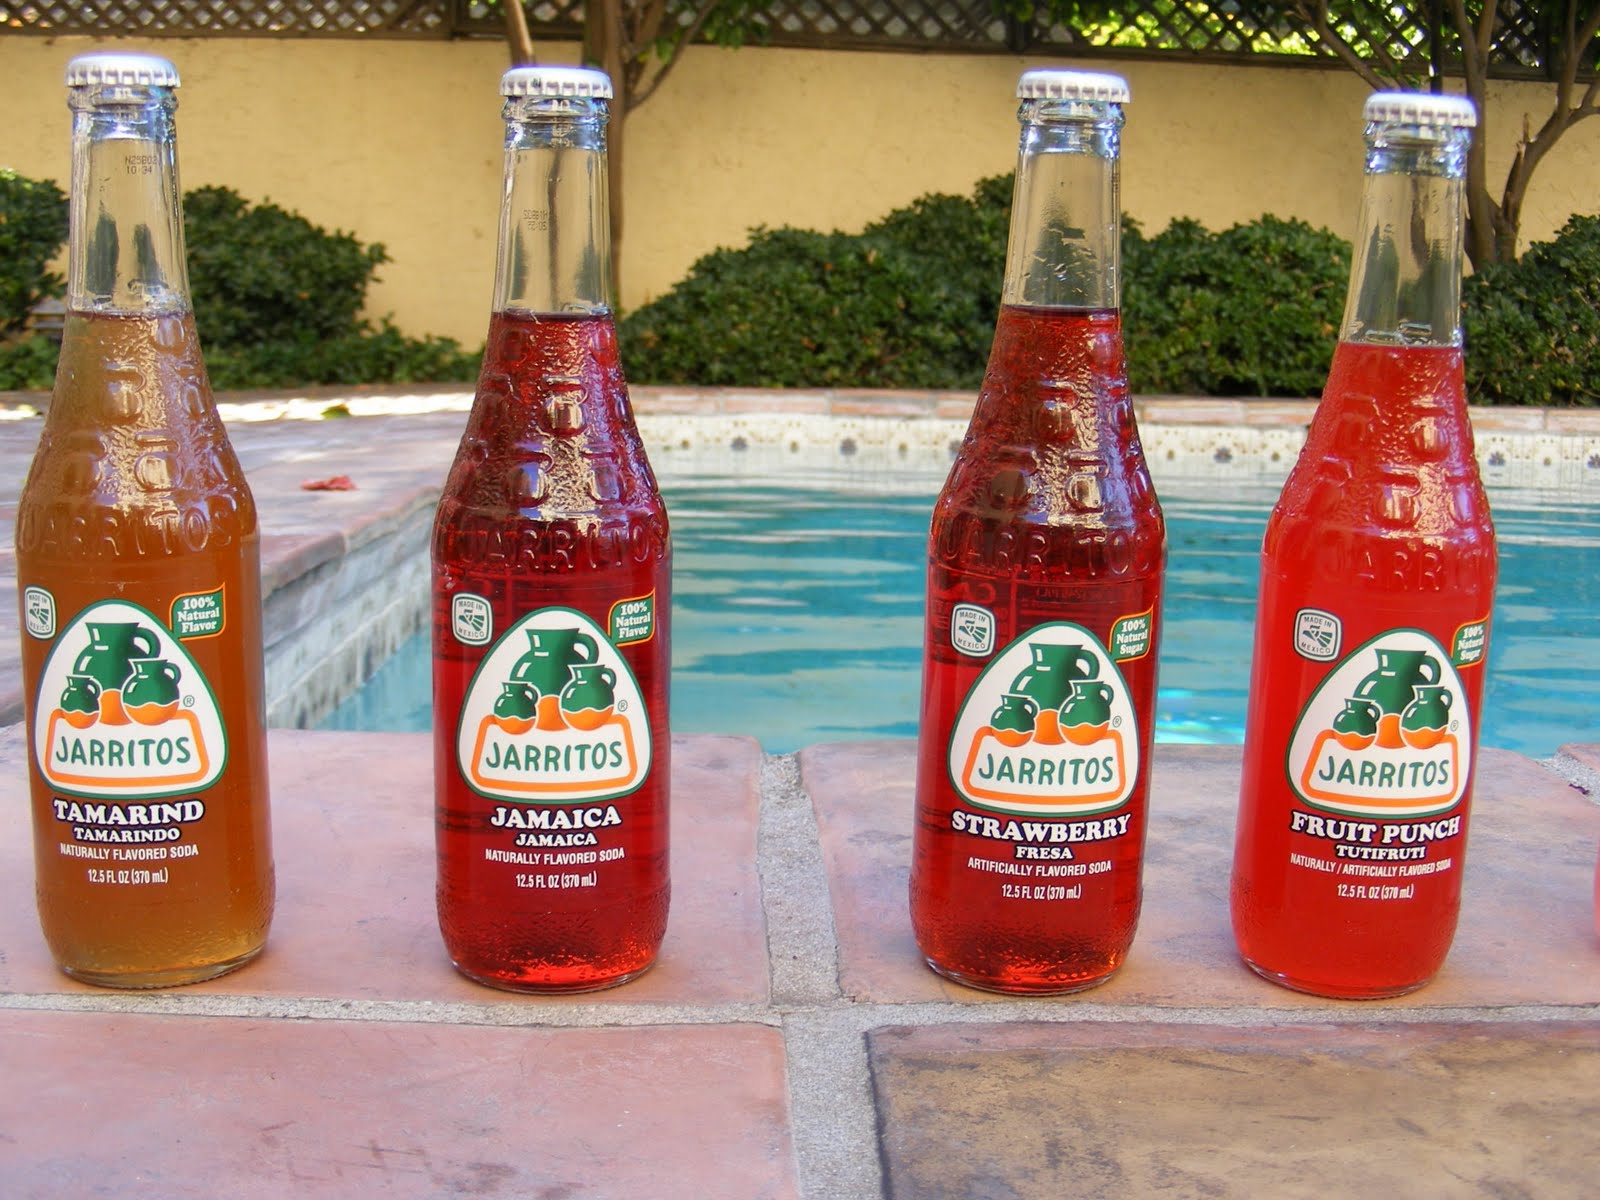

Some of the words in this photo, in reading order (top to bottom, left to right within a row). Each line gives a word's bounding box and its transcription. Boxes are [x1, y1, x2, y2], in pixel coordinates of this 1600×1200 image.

[182, 596, 216, 610] 100%
[620, 601, 648, 616] 100%
[177, 607, 220, 622] Natural
[615, 612, 651, 628] Natural
[959, 611, 977, 619] MADE
[978, 615, 986, 623] IN
[1304, 616, 1323, 625] MADE
[1324, 620, 1332, 628] IN
[181, 621, 217, 633] Flavor
[618, 626, 649, 639] Flavor
[1121, 618, 1146, 632] 100%
[957, 638, 986, 649] MEXICO
[1116, 629, 1148, 644] Natural
[1120, 643, 1144, 656] Sugar
[1301, 642, 1331, 654] MEXICO
[56, 736, 191, 766] JARRITOS
[486, 741, 623, 771] JARRITOS
[978, 753, 1114, 785] JARRITOS
[1319, 755, 1450, 787] JARRITOS
[54, 799, 204, 825] TAMARIND
[490, 806, 622, 829] JAMAICA
[73, 827, 181, 843] TAMARINDO
[952, 811, 1131, 843] STRAWBERRY
[1291, 811, 1376, 843] FRUIT
[1381, 815, 1461, 843] PUNCH
[515, 833, 598, 847] JAMAICA
[60, 843, 110, 860] NATURALLY
[113, 848, 167, 860] FLAVORED
[170, 844, 199, 858] SODA
[485, 849, 541, 865] NATURALLY
[544, 852, 597, 865] FLAVORED
[599, 848, 625, 862] SODA
[1016, 846, 1073, 859] FRESA
[1336, 845, 1426, 860] TUTIFRUTI
[968, 857, 1033, 876] ARTIFICIALLY
[1035, 864, 1086, 877] FLAVORED
[1088, 860, 1112, 874] SODA
[1290, 853, 1336, 872] NATURALLY
[1342, 864, 1398, 877] ARTIFICIALLY
[1399, 863, 1435, 877] FLAVORED
[88, 869, 105, 883] 12.5
[106, 870, 116, 883] FL
[118, 871, 129, 884] OZ
[131, 869, 150, 885] (370
[152, 867, 169, 884] mL)
[516, 874, 534, 888] 12.5
[536, 875, 546, 888] FL
[548, 875, 559, 889] OZ
[561, 873, 579, 889] (370
[581, 871, 597, 887] mL)
[1002, 884, 1019, 898] 12.5
[1022, 886, 1031, 899] FL
[1034, 886, 1045, 899] OZ
[1047, 885, 1065, 900] (370
[1067, 883, 1082, 899] mL)
[1337, 884, 1355, 897] 12.5
[1357, 886, 1366, 898] FL
[1368, 886, 1380, 899] OZ
[1381, 885, 1398, 900] (370
